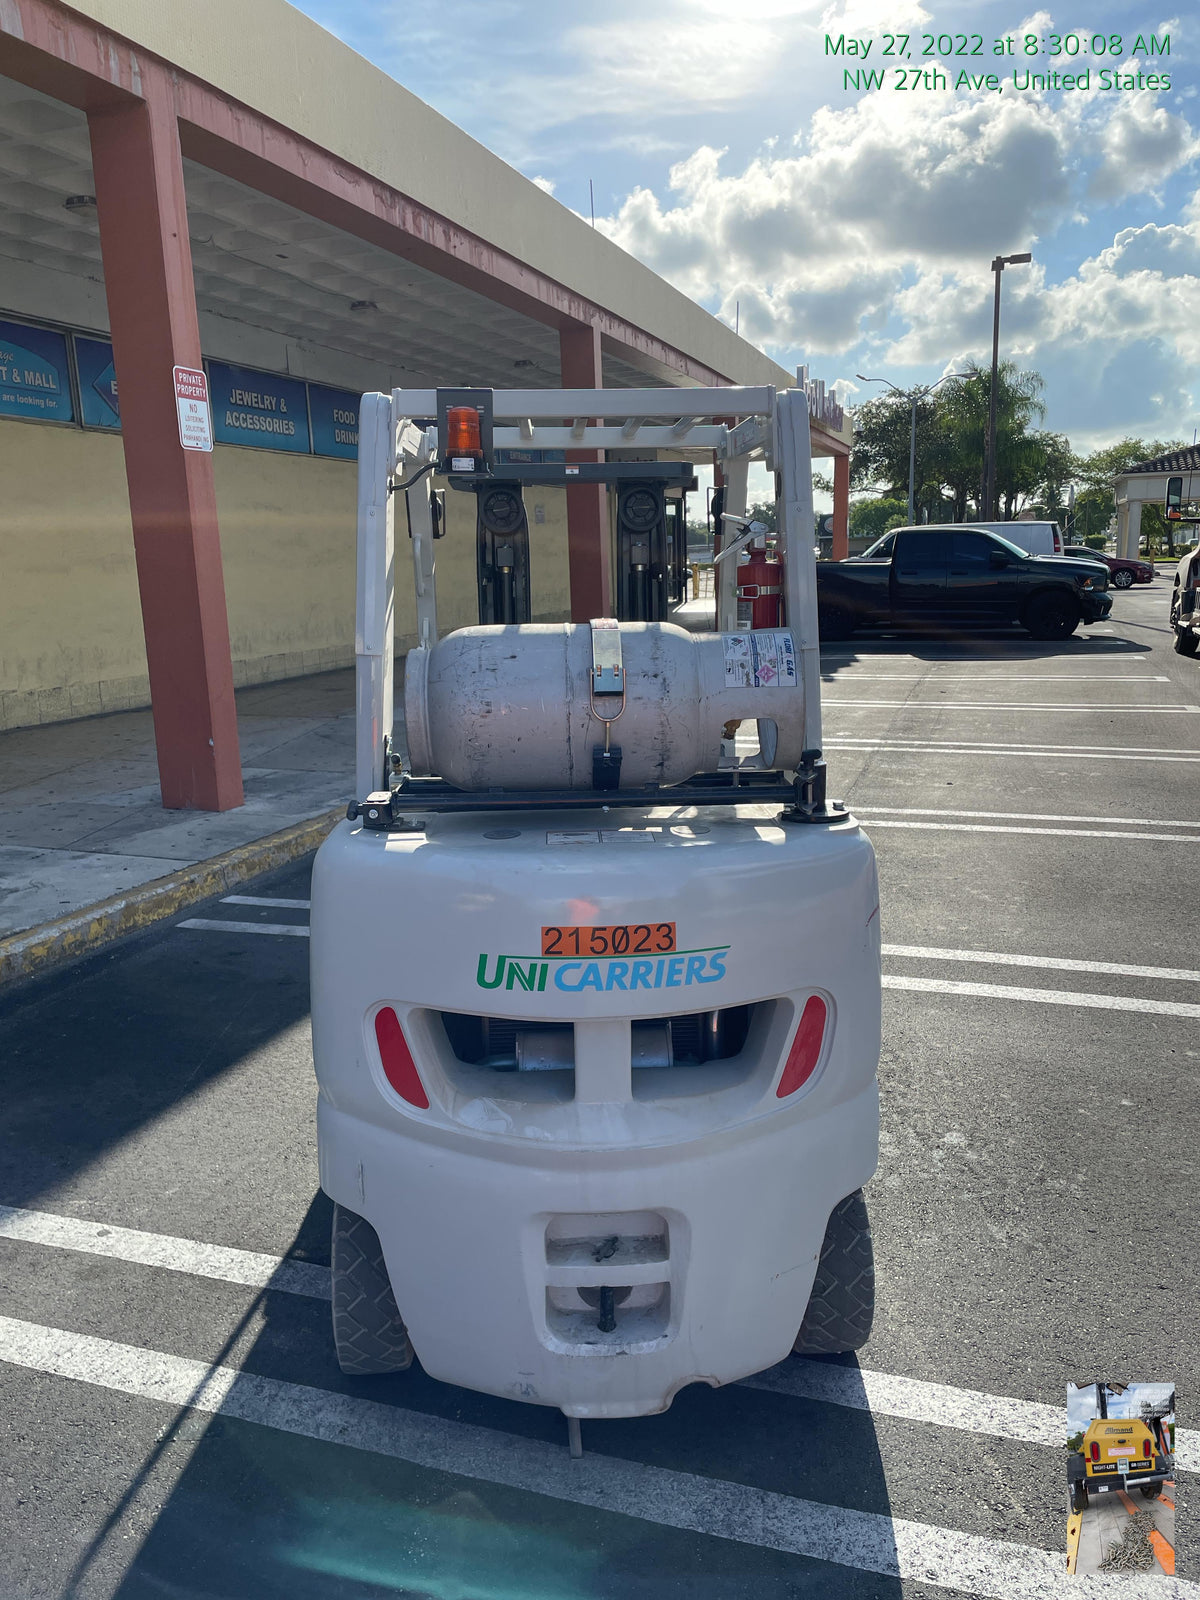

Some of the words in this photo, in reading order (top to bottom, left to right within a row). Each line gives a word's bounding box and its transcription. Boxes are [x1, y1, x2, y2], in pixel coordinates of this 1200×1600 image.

[12, 368, 22, 384] &
[25, 370, 57, 389] MALL
[179, 373, 202, 386] PRIVATE
[177, 384, 206, 397] PROPERTY
[2, 393, 15, 402] are
[17, 394, 45, 409] looking
[189, 403, 198, 414] NO
[229, 388, 277, 411] JEWELRY
[280, 398, 288, 413] &
[225, 410, 296, 436] ACCESSORIES
[333, 408, 356, 425] FOOD
[544, 923, 674, 954] 215023
